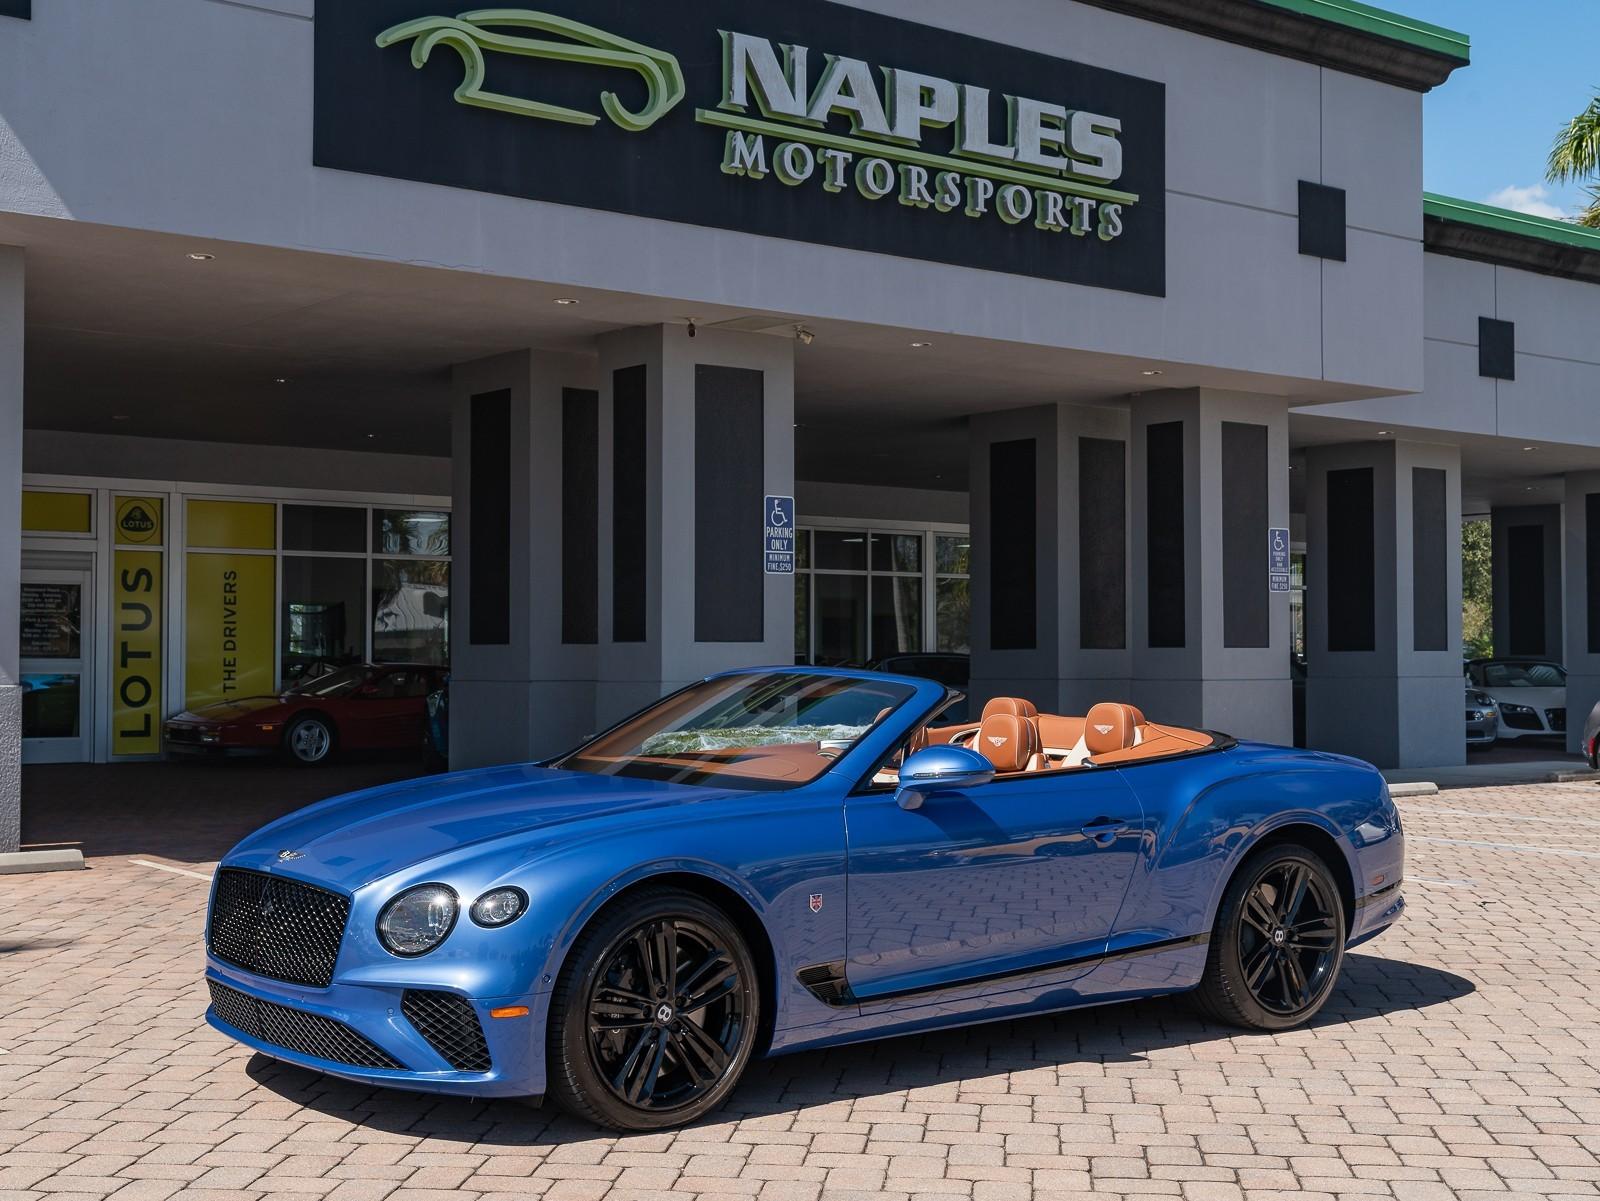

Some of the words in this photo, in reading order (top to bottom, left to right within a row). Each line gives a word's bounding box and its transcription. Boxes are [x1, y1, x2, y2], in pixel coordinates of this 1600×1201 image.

[717, 29, 1123, 183] NAPLES
[720, 130, 1124, 241] MOTORSPORTS
[123, 520, 153, 528] LOTUS
[766, 526, 792, 538] PARKING
[771, 539, 788, 550] ONLY
[223, 569, 237, 651] DRIVERS
[120, 566, 153, 739] LOTUS
[223, 653, 237, 693] THE
